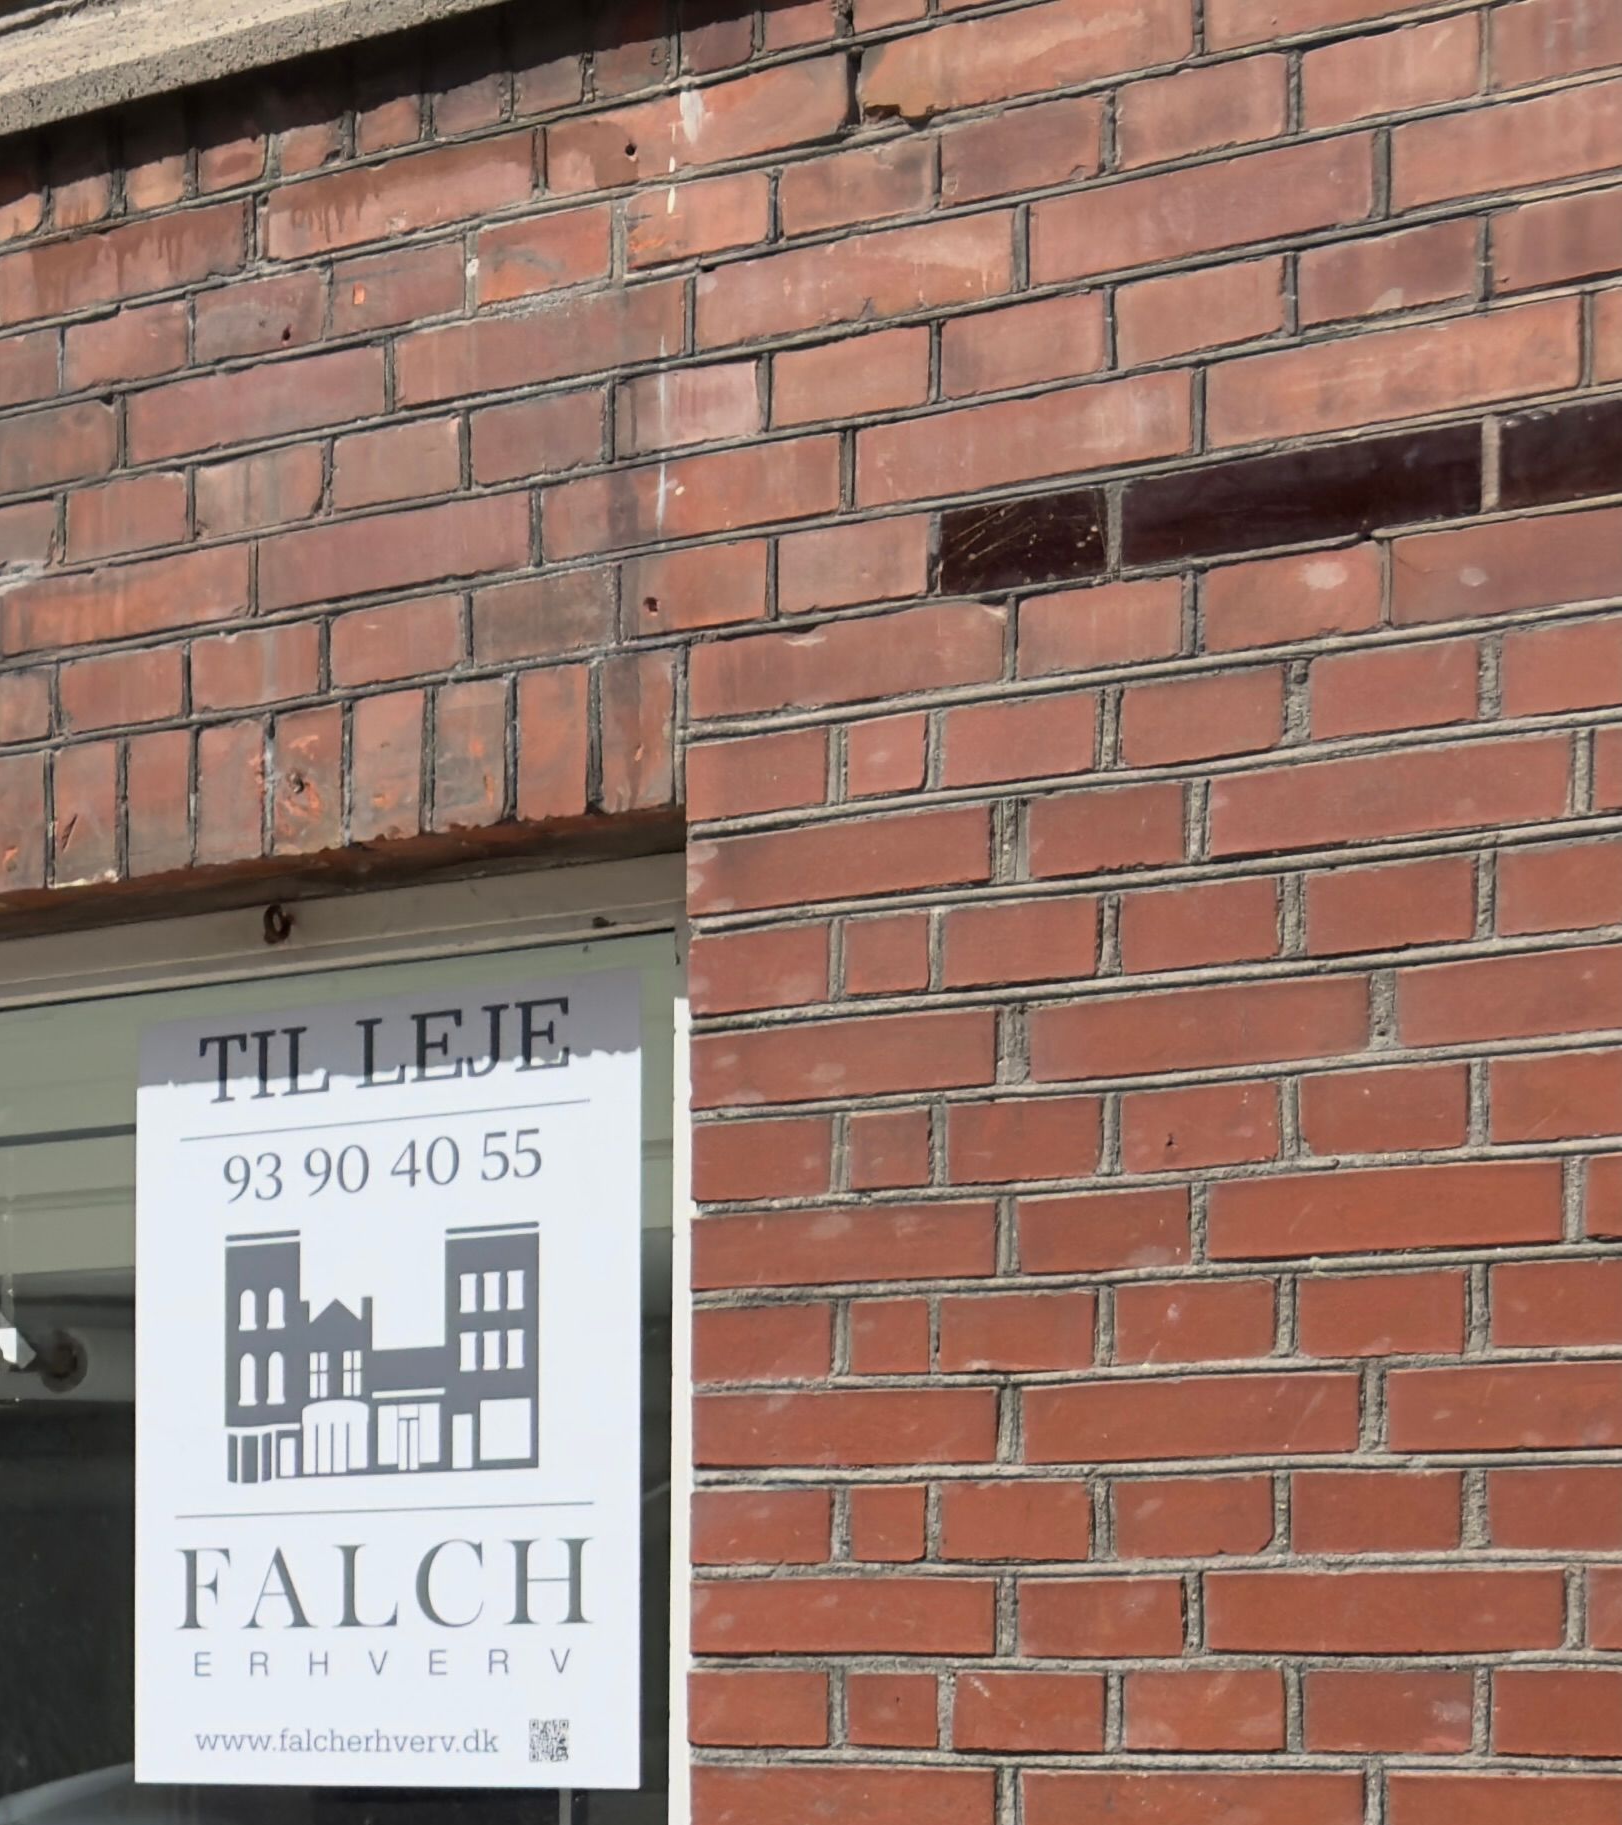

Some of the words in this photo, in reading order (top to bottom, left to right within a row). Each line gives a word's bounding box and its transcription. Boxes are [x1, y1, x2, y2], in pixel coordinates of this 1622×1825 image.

[198, 1025, 330, 1104] TIL
[355, 996, 571, 1092] LEJE
[223, 1151, 282, 1204] 93
[303, 1145, 370, 1196] 90
[391, 1136, 459, 1187] 40
[480, 1128, 542, 1182] 55
[176, 1536, 594, 1631] FALCH
[194, 1649, 572, 1678] ERHVERV
[195, 1728, 499, 1757] www.falcherhverv.dk
